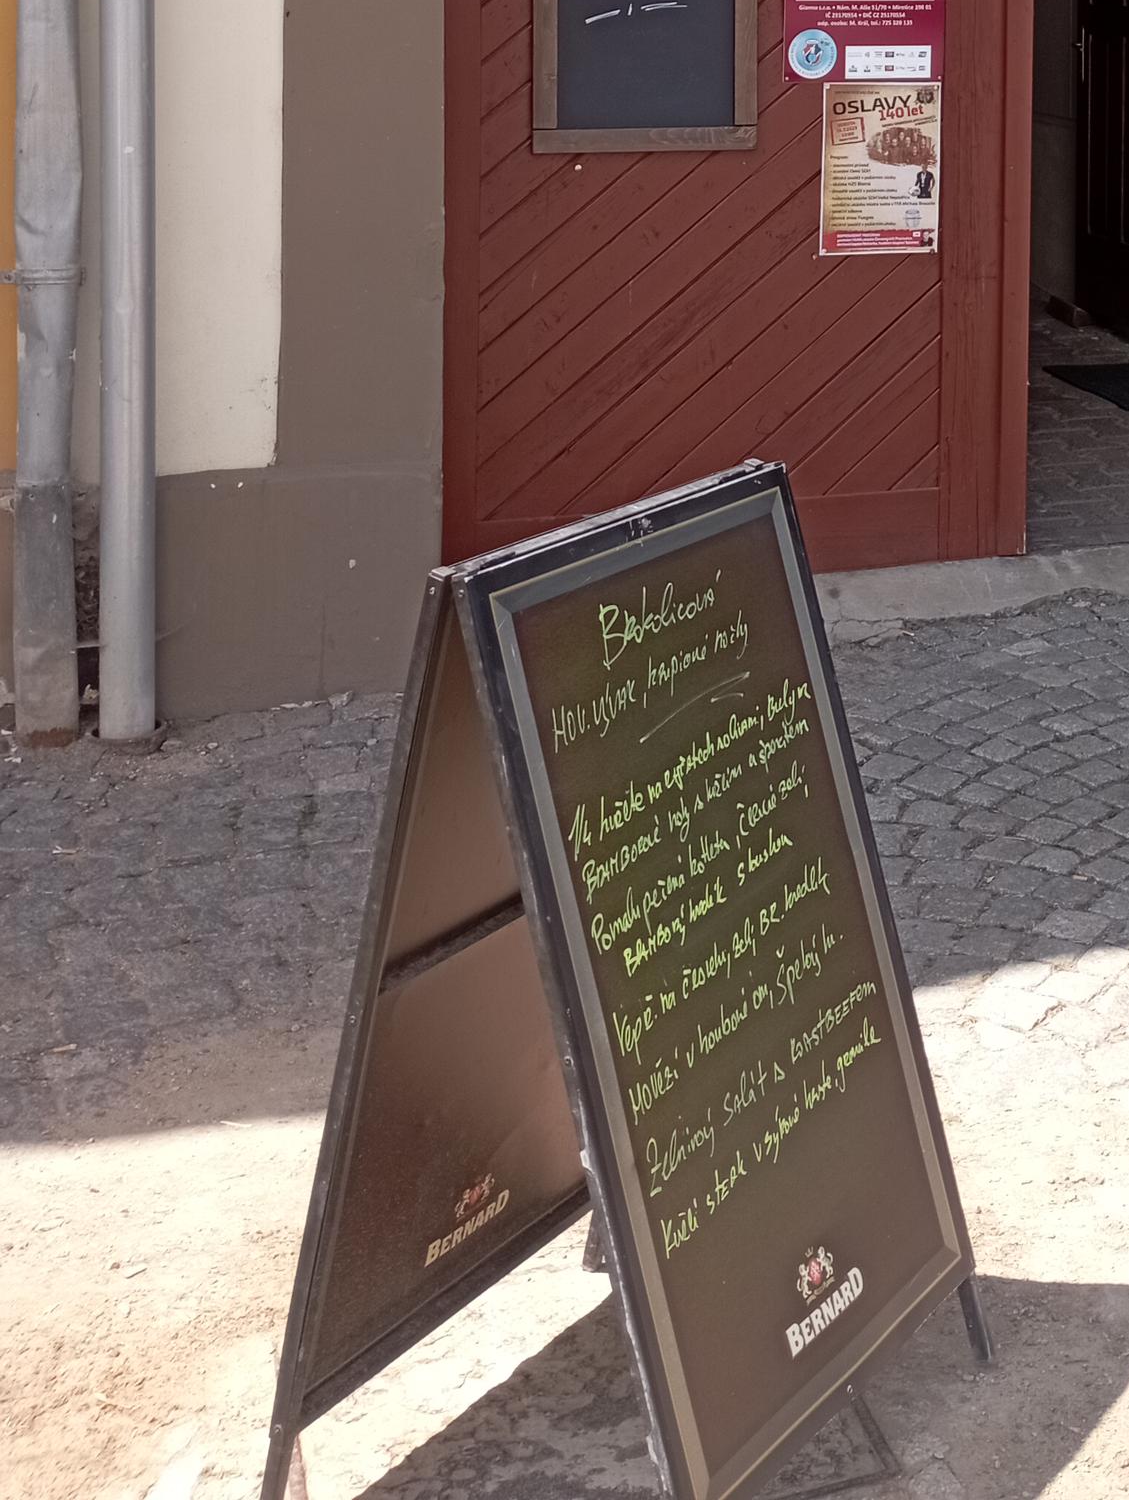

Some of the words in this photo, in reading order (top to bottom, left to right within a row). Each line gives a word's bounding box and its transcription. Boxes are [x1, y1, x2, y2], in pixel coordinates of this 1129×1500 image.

[833, 95, 911, 115] OSLAVY
[879, 107, 905, 121] 140
[907, 105, 924, 116] let
[424, 1189, 510, 1268] BERNARD
[785, 1267, 864, 1359] BERNARD
